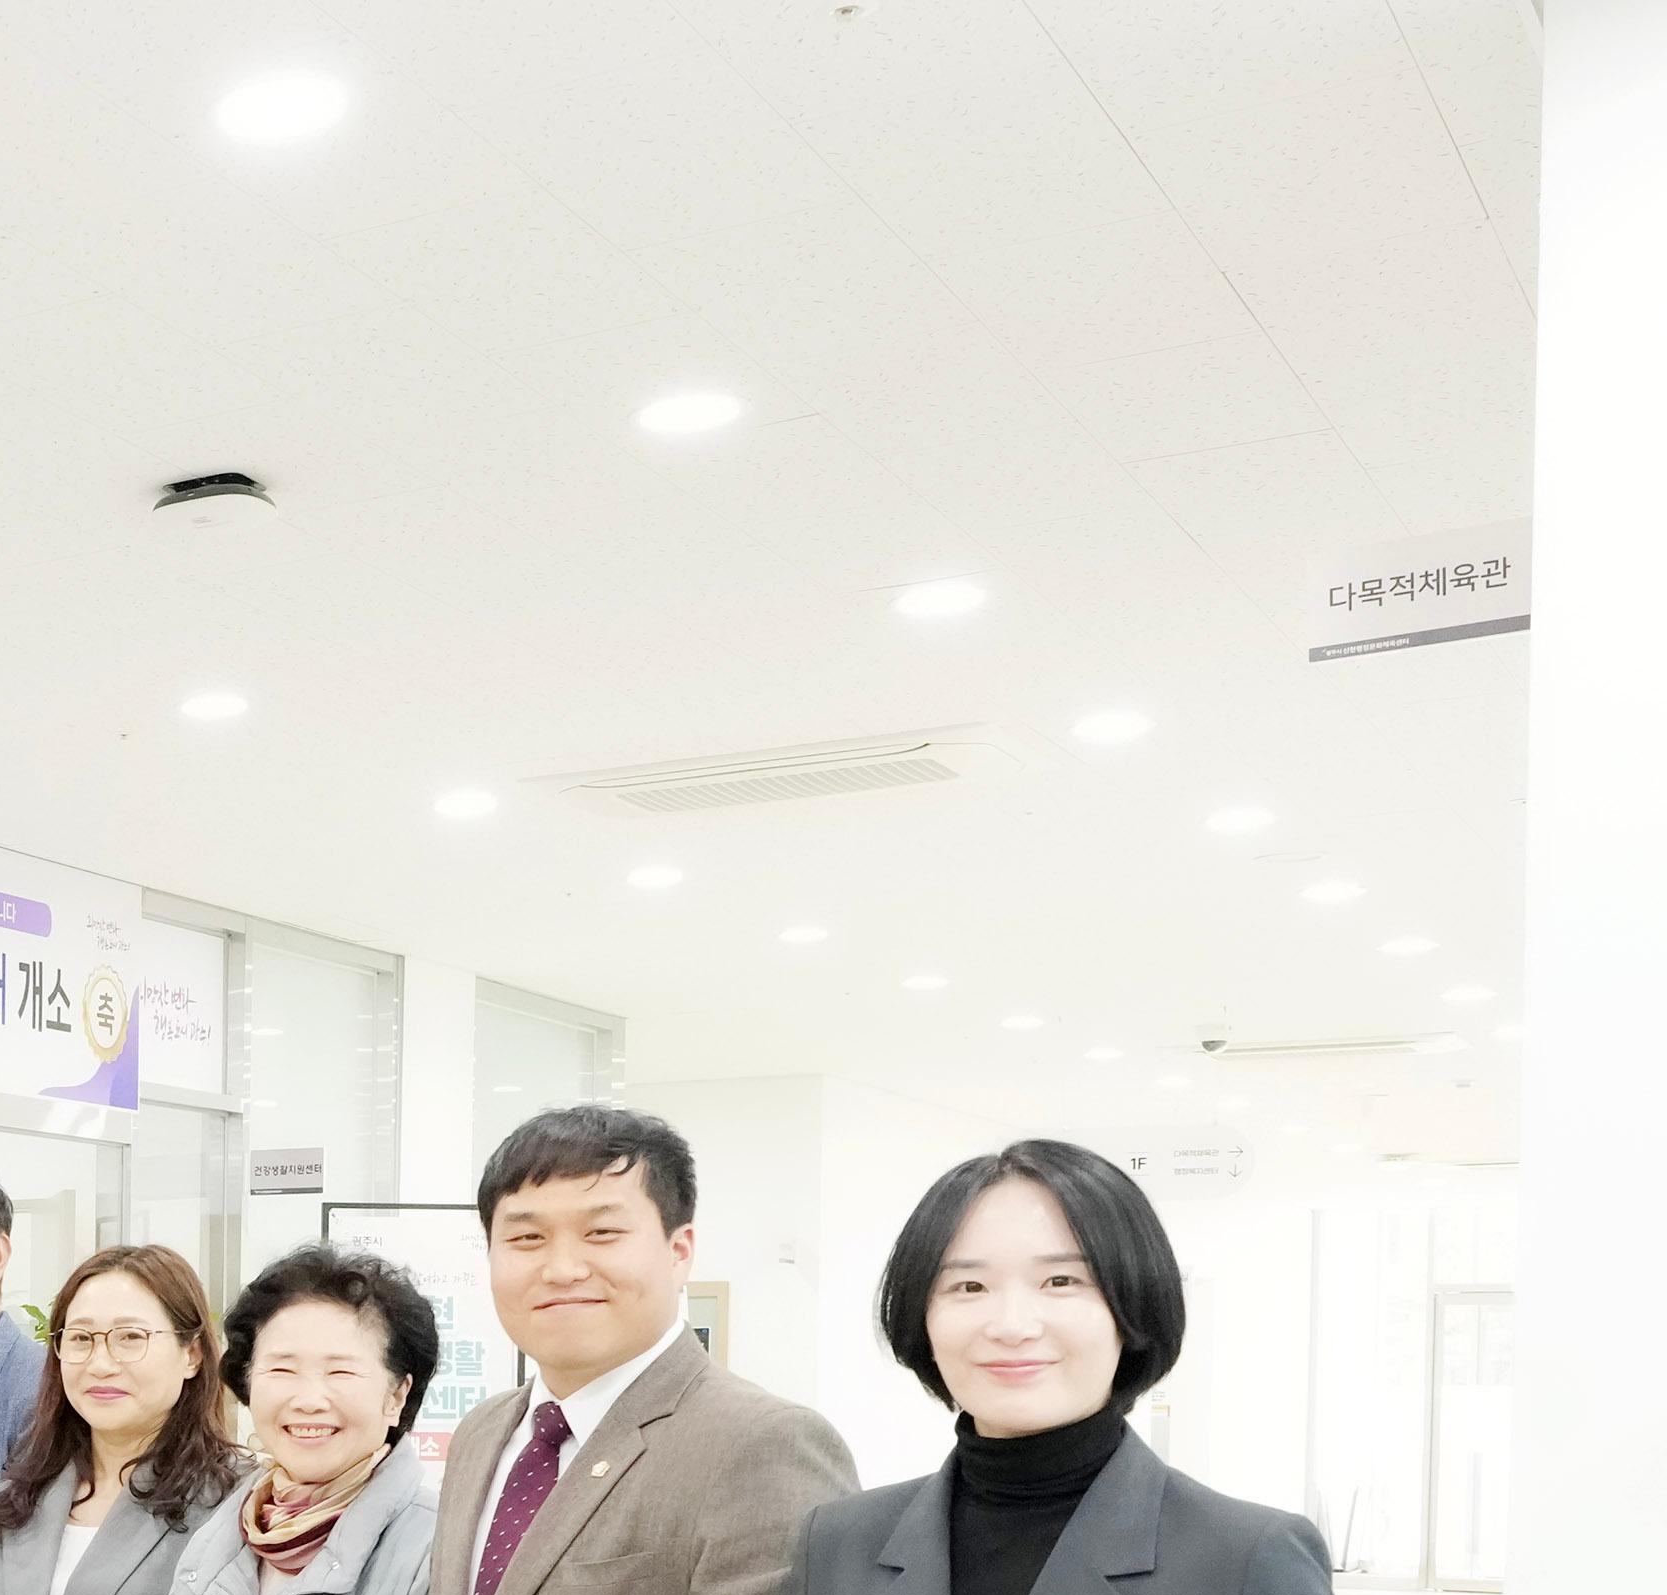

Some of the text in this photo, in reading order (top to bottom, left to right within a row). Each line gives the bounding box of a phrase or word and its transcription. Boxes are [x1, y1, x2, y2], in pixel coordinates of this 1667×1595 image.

[1328, 555, 1512, 612] 다목적체육관
[17, 960, 73, 1033] 개소
[96, 992, 115, 1036] 축
[253, 1161, 323, 1178] 건강생활지원센터
[1130, 1157, 1148, 1171] 1F
